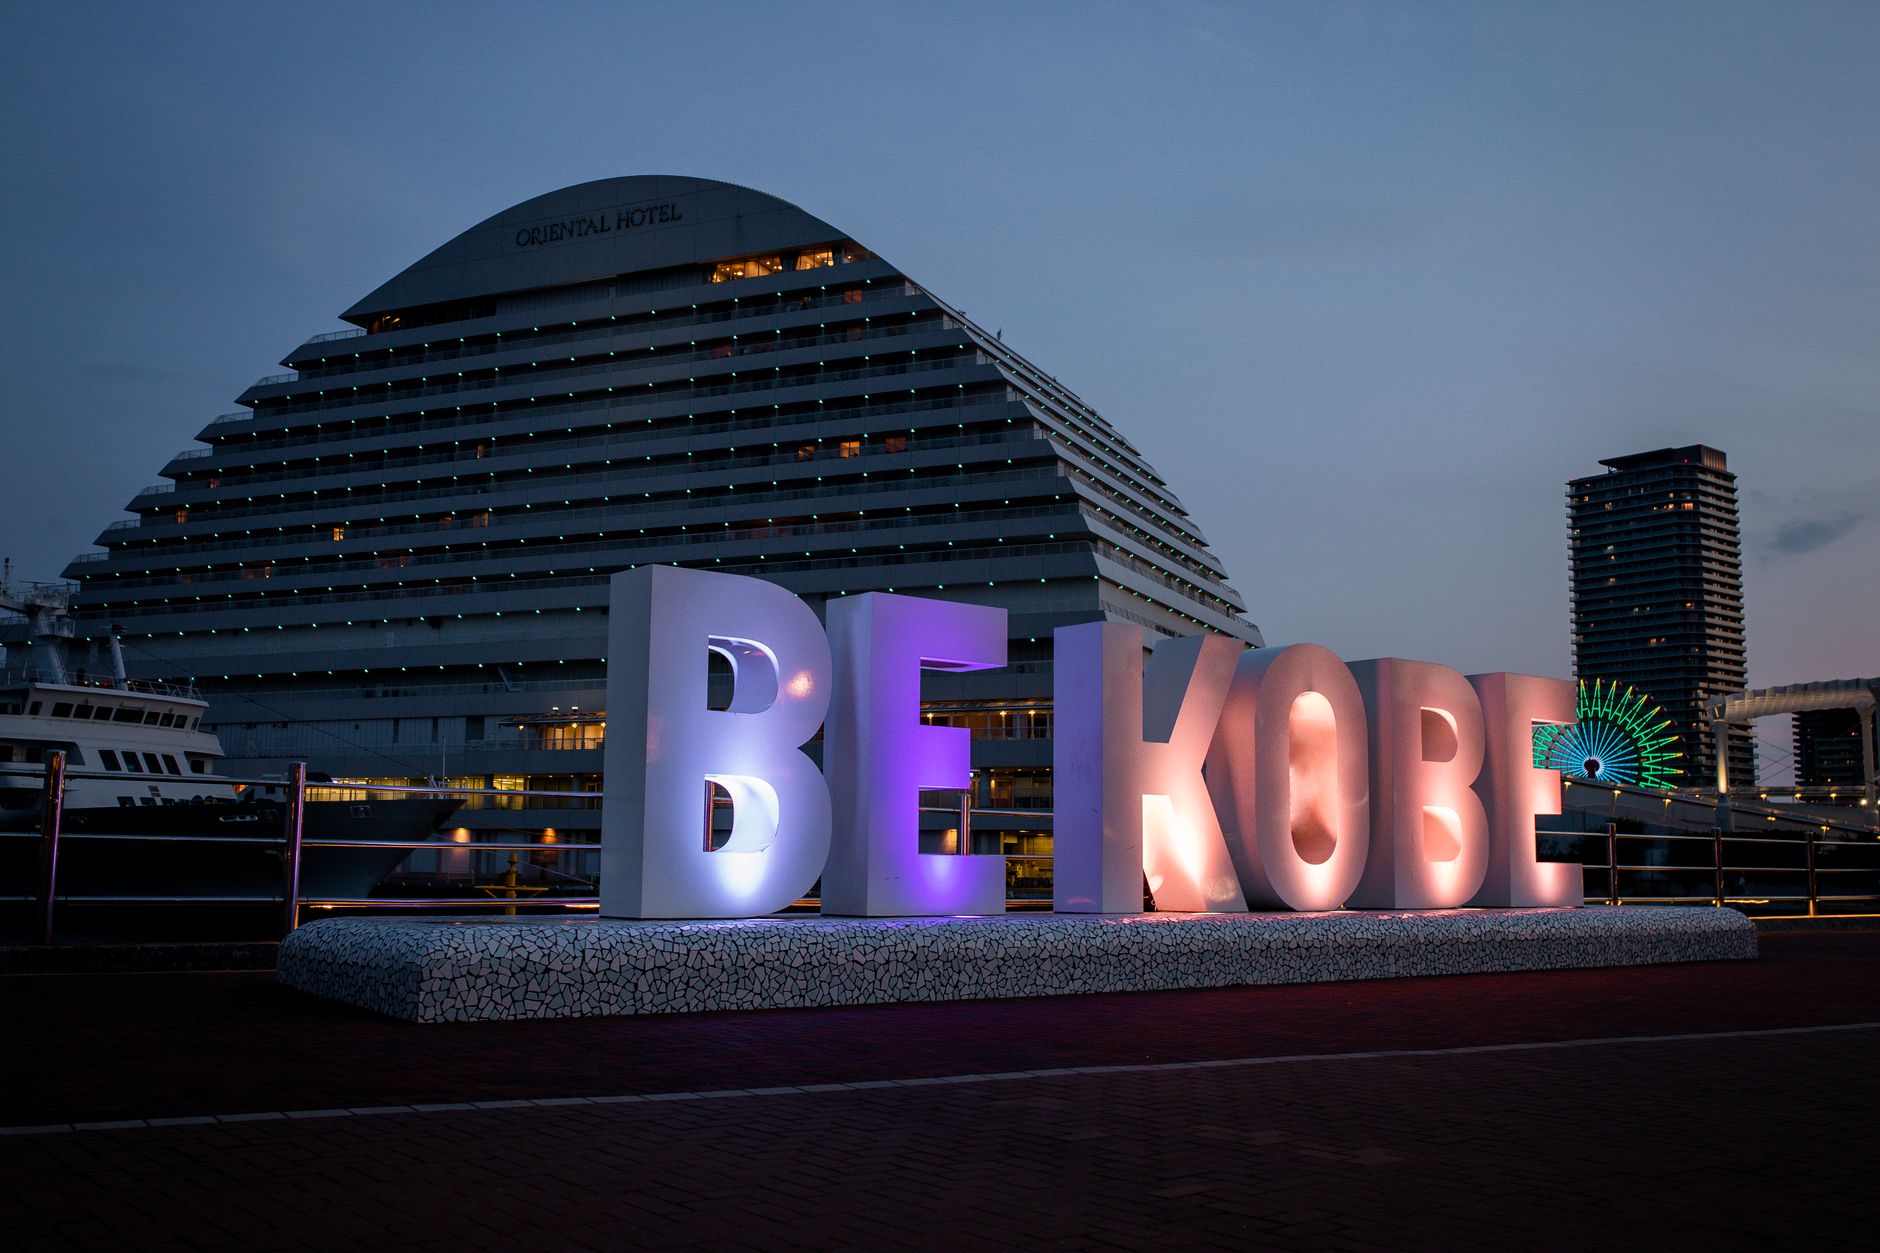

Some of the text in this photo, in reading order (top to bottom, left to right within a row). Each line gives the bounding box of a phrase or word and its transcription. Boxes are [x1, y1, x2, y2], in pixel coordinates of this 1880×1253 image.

[516, 203, 682, 247] ORIENTAL HOTEL
[602, 564, 1584, 919] BE KOBE
